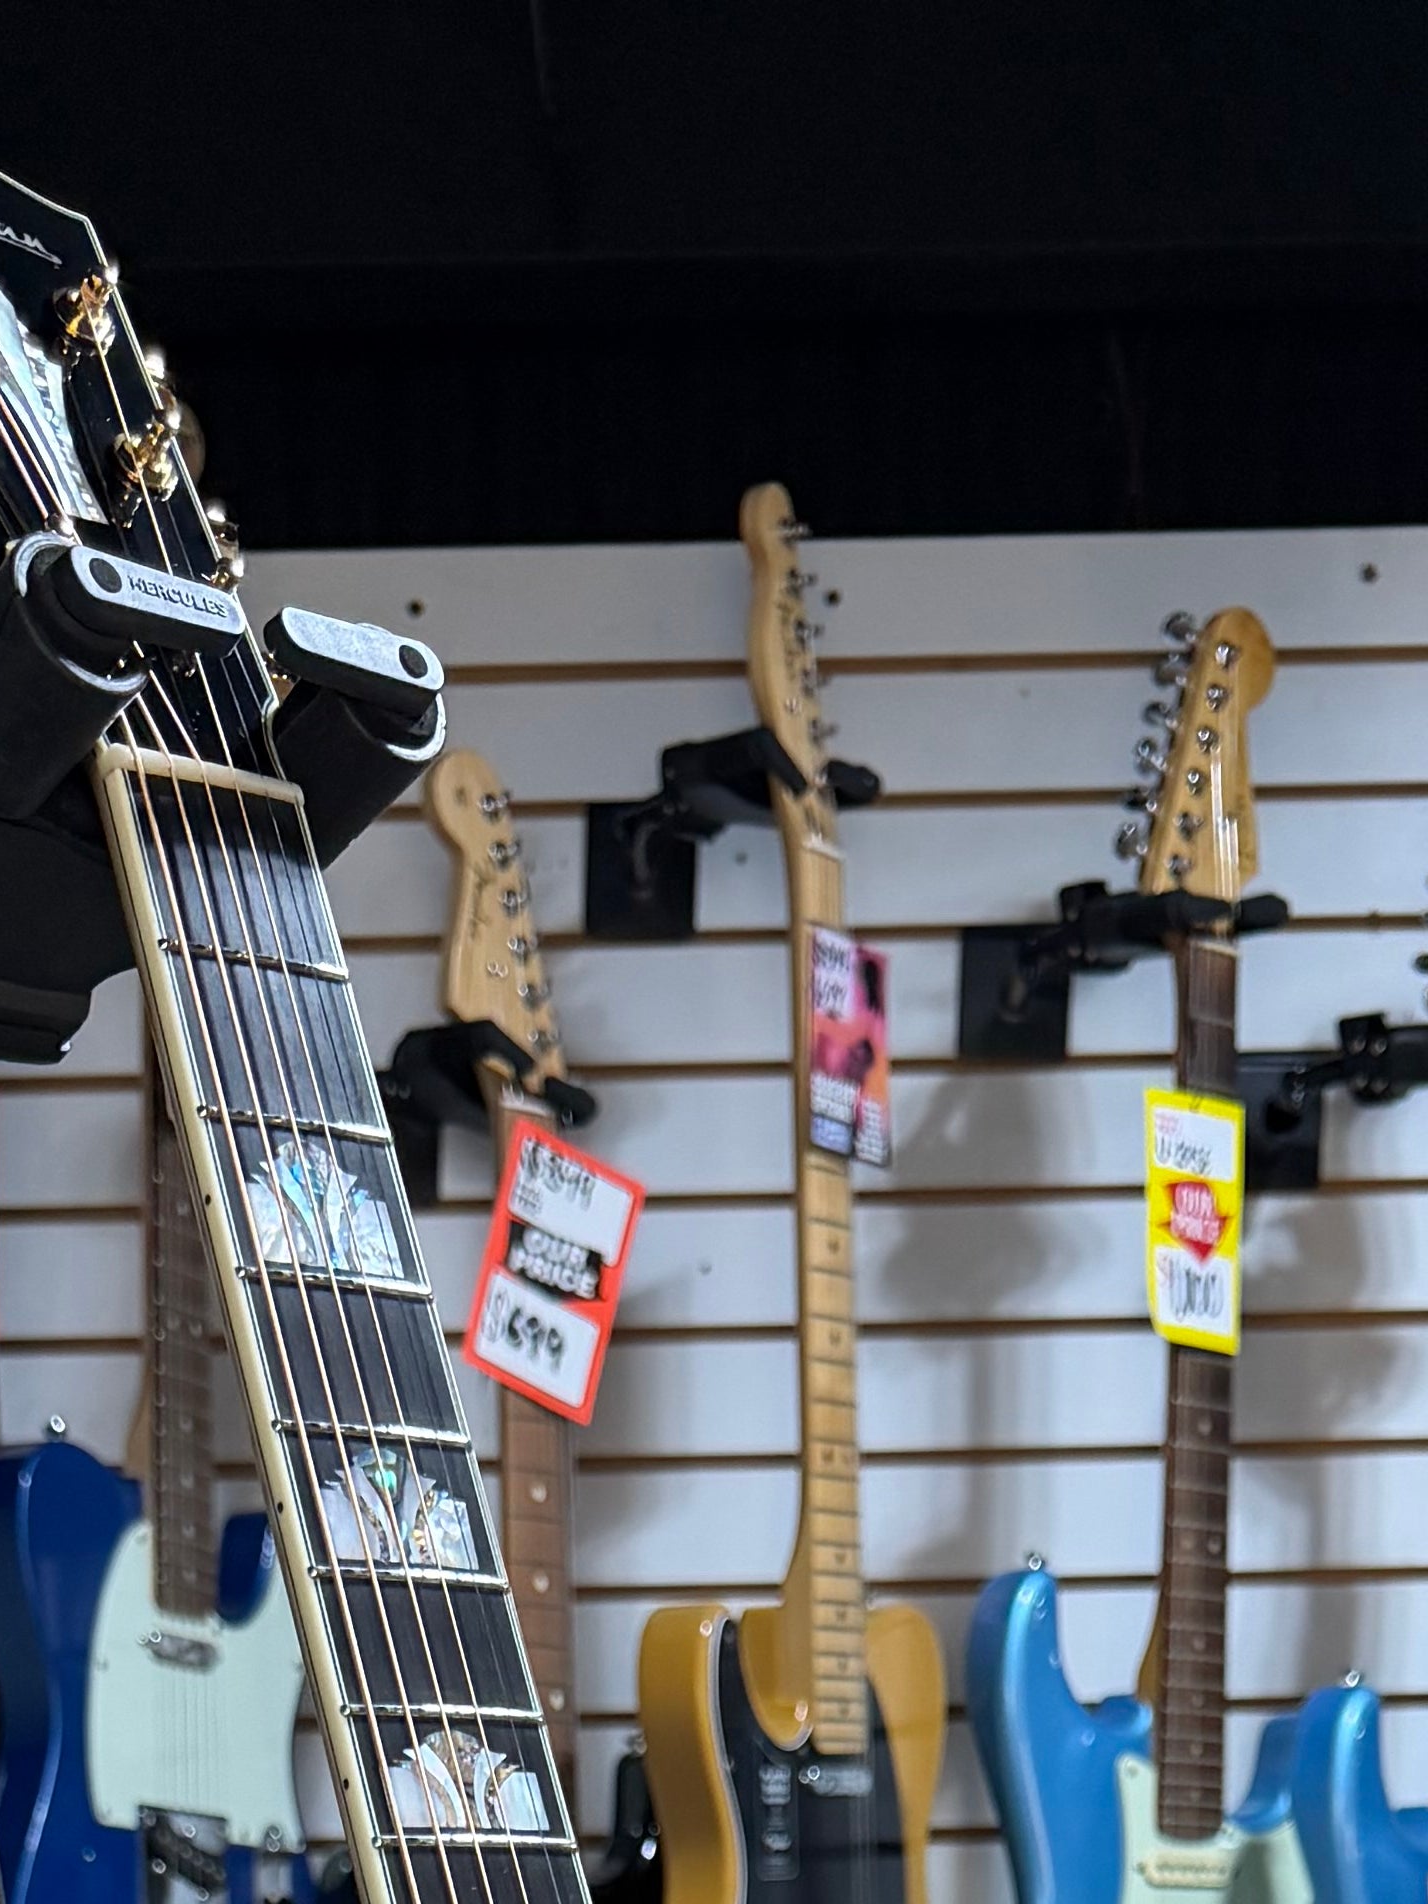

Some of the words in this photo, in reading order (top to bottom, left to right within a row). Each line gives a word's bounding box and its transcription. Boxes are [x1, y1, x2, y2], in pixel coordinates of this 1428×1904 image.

[127, 575, 228, 618] HERCULES
[523, 1225, 588, 1272] OUR
[507, 1246, 600, 1301] PRICE
